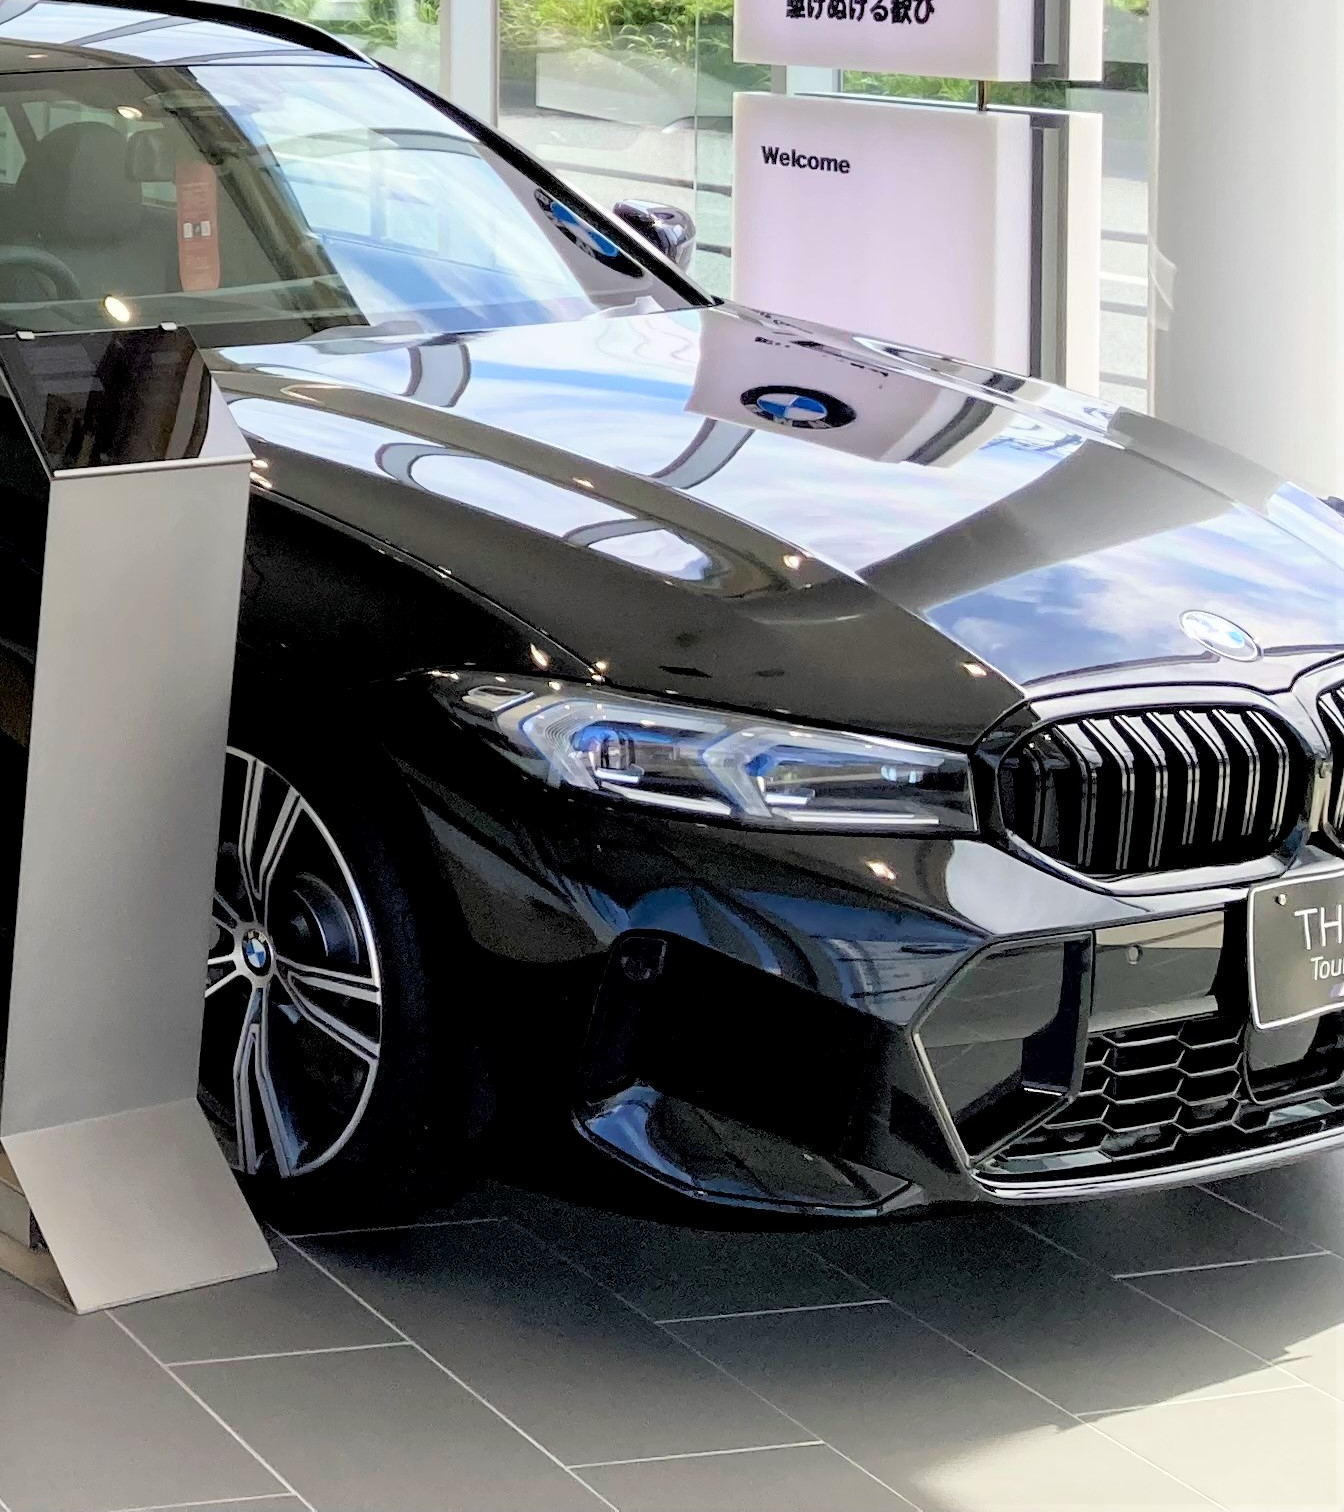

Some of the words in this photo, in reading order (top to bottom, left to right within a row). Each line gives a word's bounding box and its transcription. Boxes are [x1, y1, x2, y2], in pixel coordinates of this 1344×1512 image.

[761, 144, 851, 174] Welcome
[1294, 904, 1343, 950] TH
[1311, 956, 1344, 981] Tou
